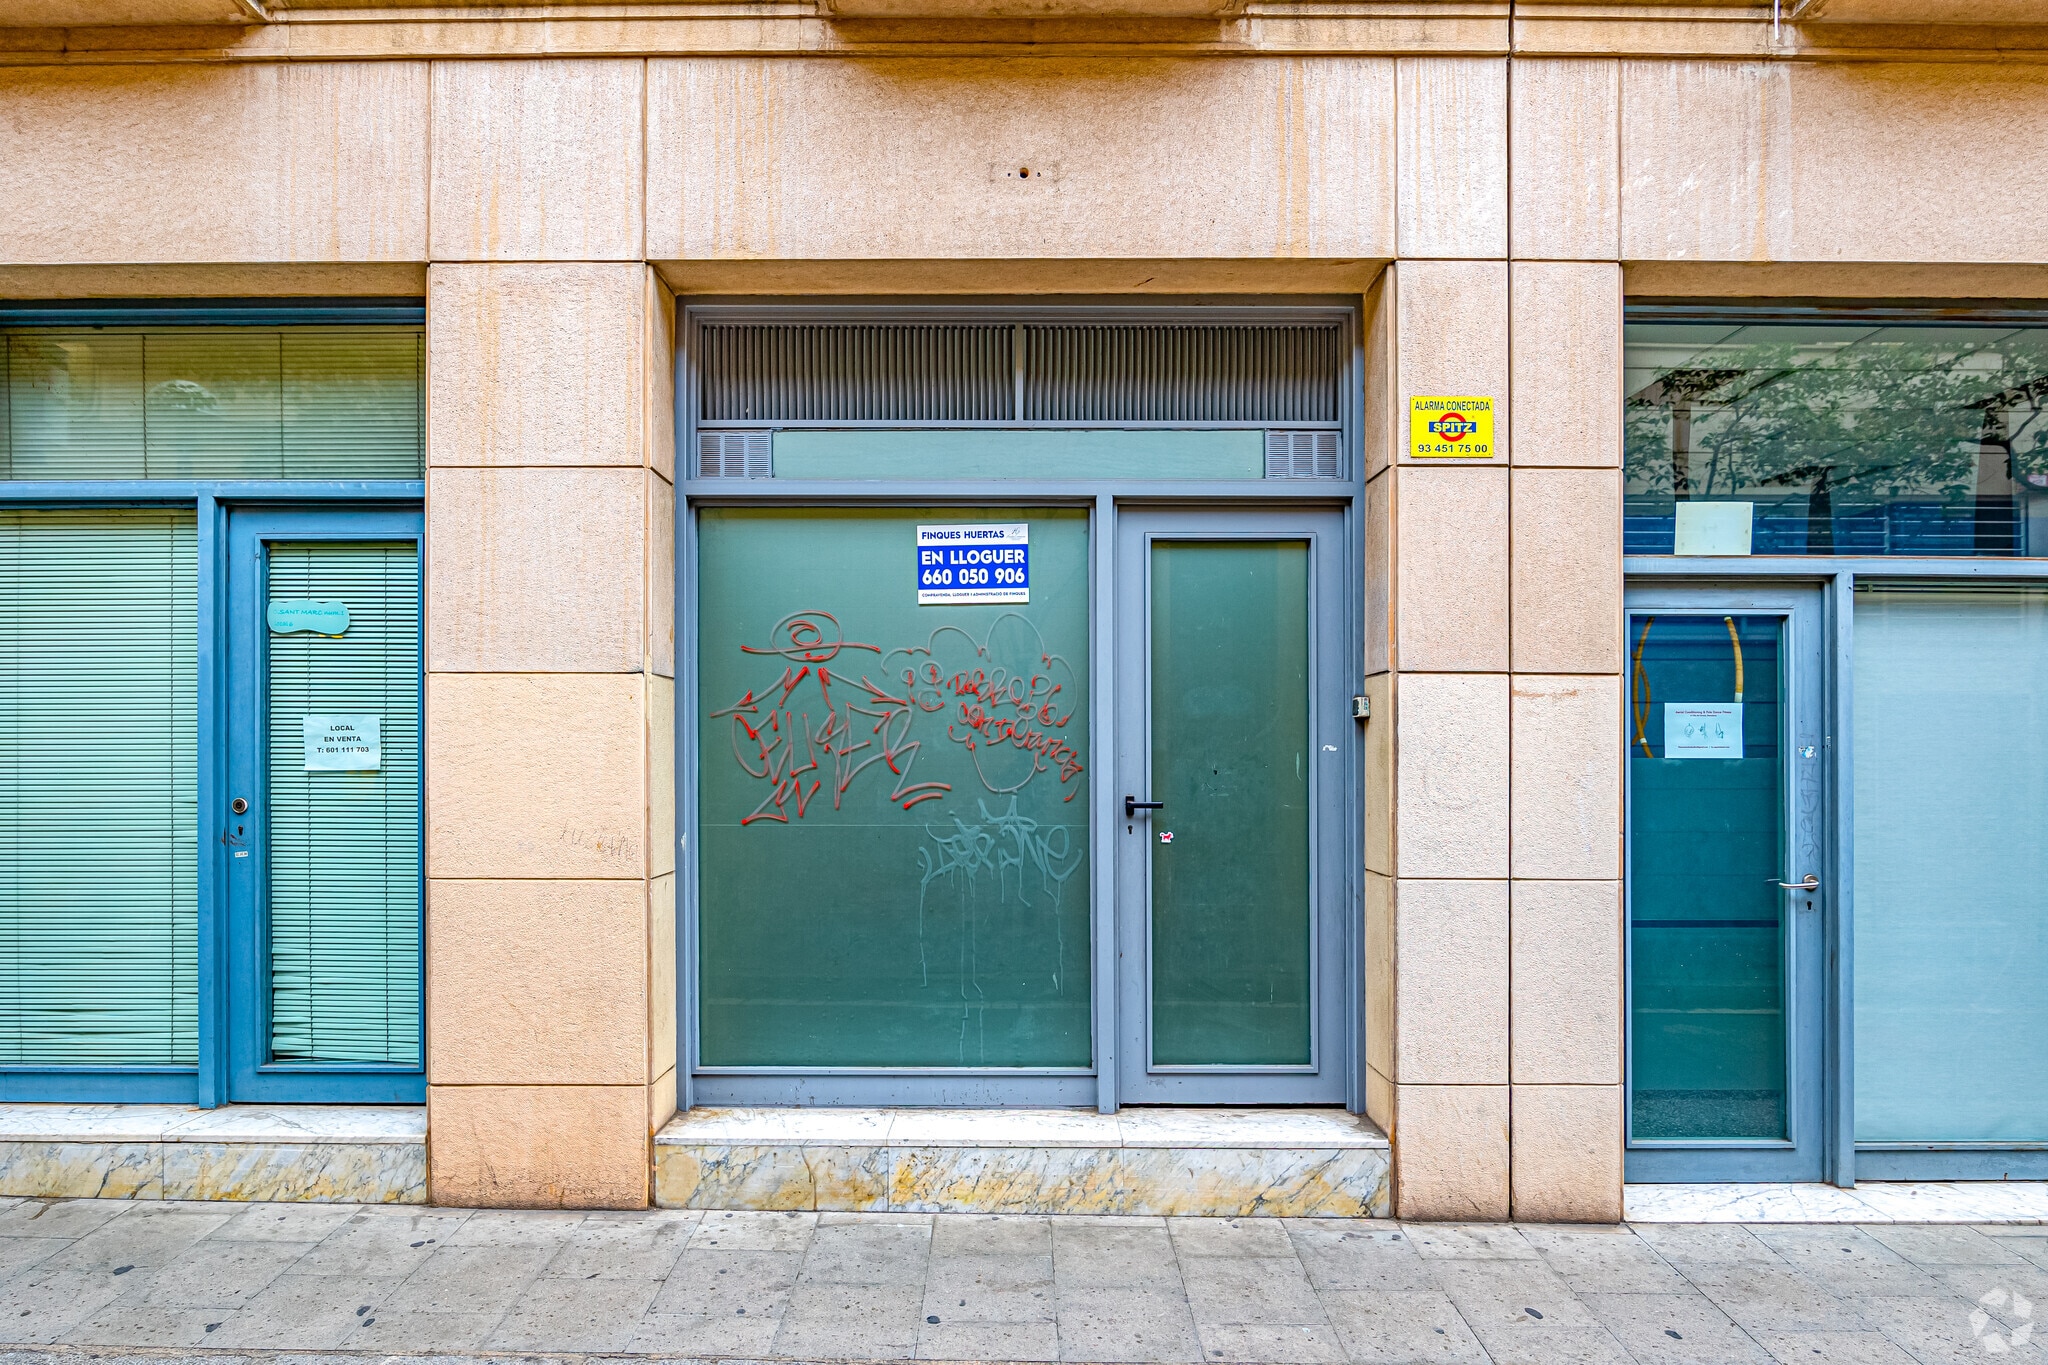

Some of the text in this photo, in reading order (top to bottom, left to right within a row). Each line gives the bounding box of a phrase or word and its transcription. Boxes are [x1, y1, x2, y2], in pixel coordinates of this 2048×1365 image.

[1415, 401, 1490, 410] ALARMA CONECTADA
[1433, 422, 1472, 432] SPITZ
[1418, 444, 1488, 452] 93 451 75 00
[922, 530, 1004, 540] FINQUES HUERTAS
[922, 550, 1025, 565] EN LLOGUER
[922, 568, 1025, 585] 660 050 906
